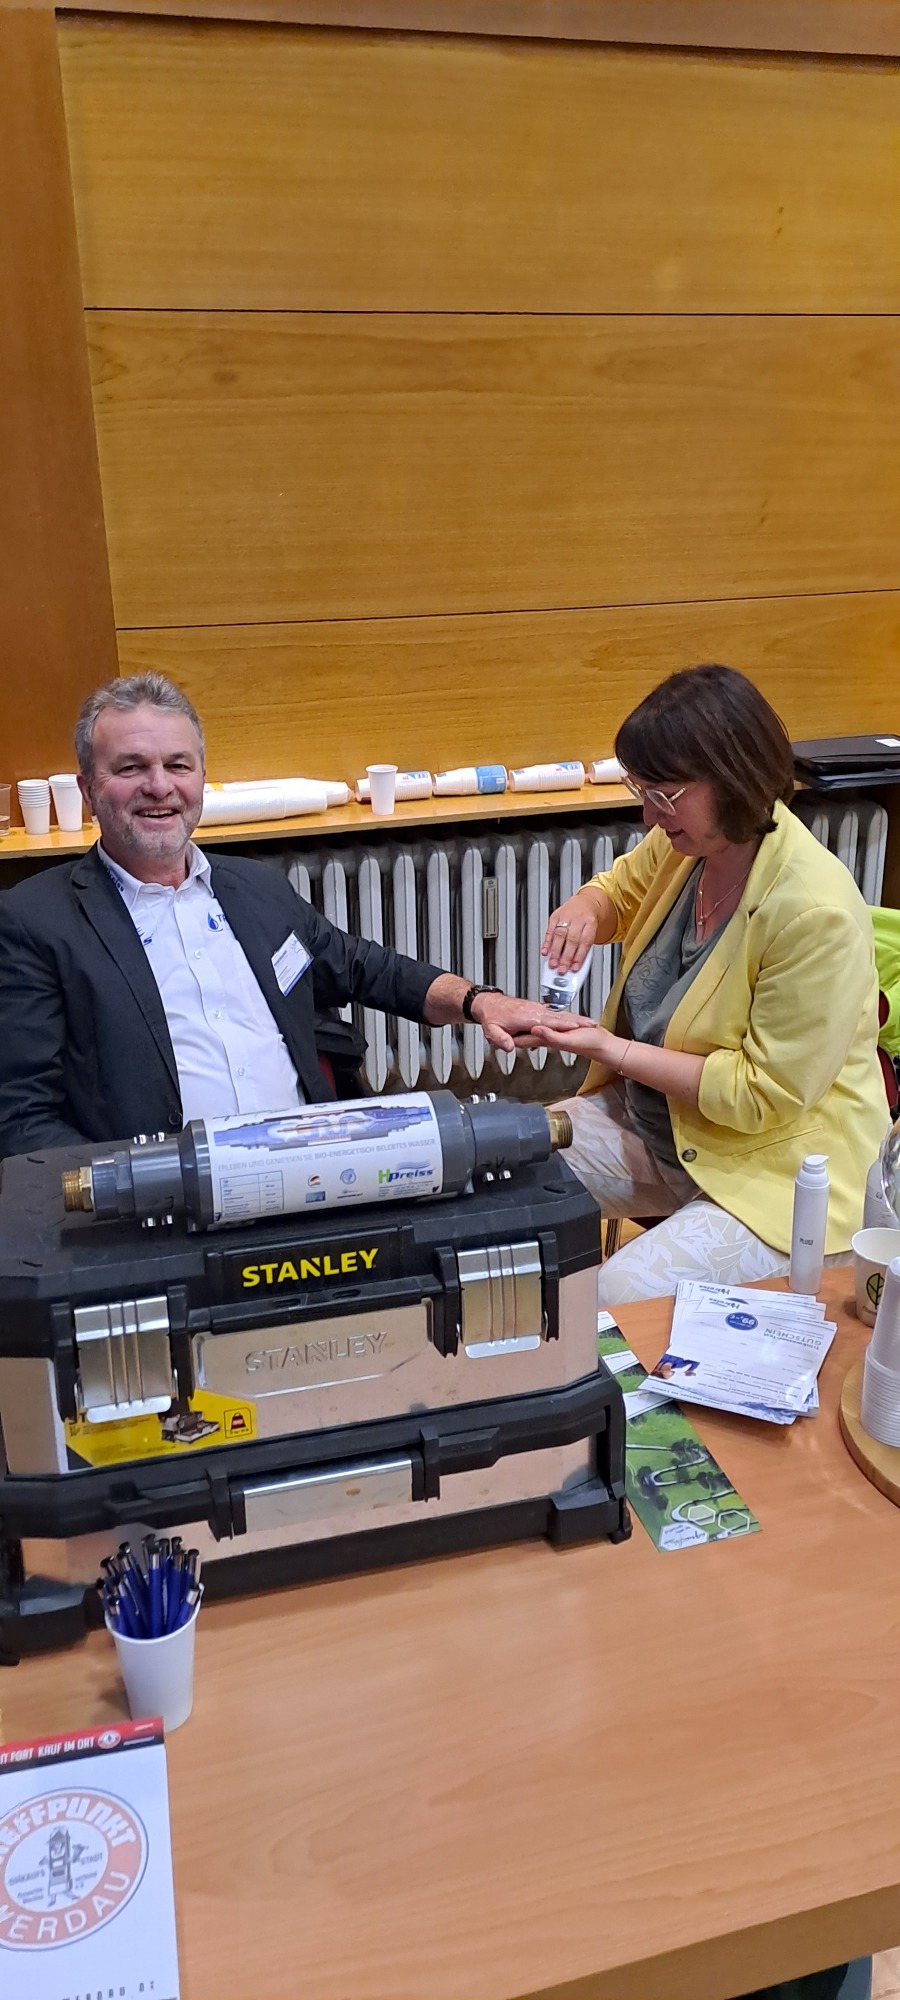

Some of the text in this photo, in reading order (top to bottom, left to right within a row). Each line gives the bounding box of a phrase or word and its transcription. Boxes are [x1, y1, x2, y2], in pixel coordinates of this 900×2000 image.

[217, 1161, 248, 1172] ERLEBEN
[248, 1159, 264, 1168] UND
[408, 1138, 436, 1149] WASSER
[242, 1248, 379, 1288] STANLEY
[245, 1331, 388, 1375] STANLEY
[765, 1328, 822, 1346] GUTSCHEIN
[37, 1742, 62, 1758] KAUF
